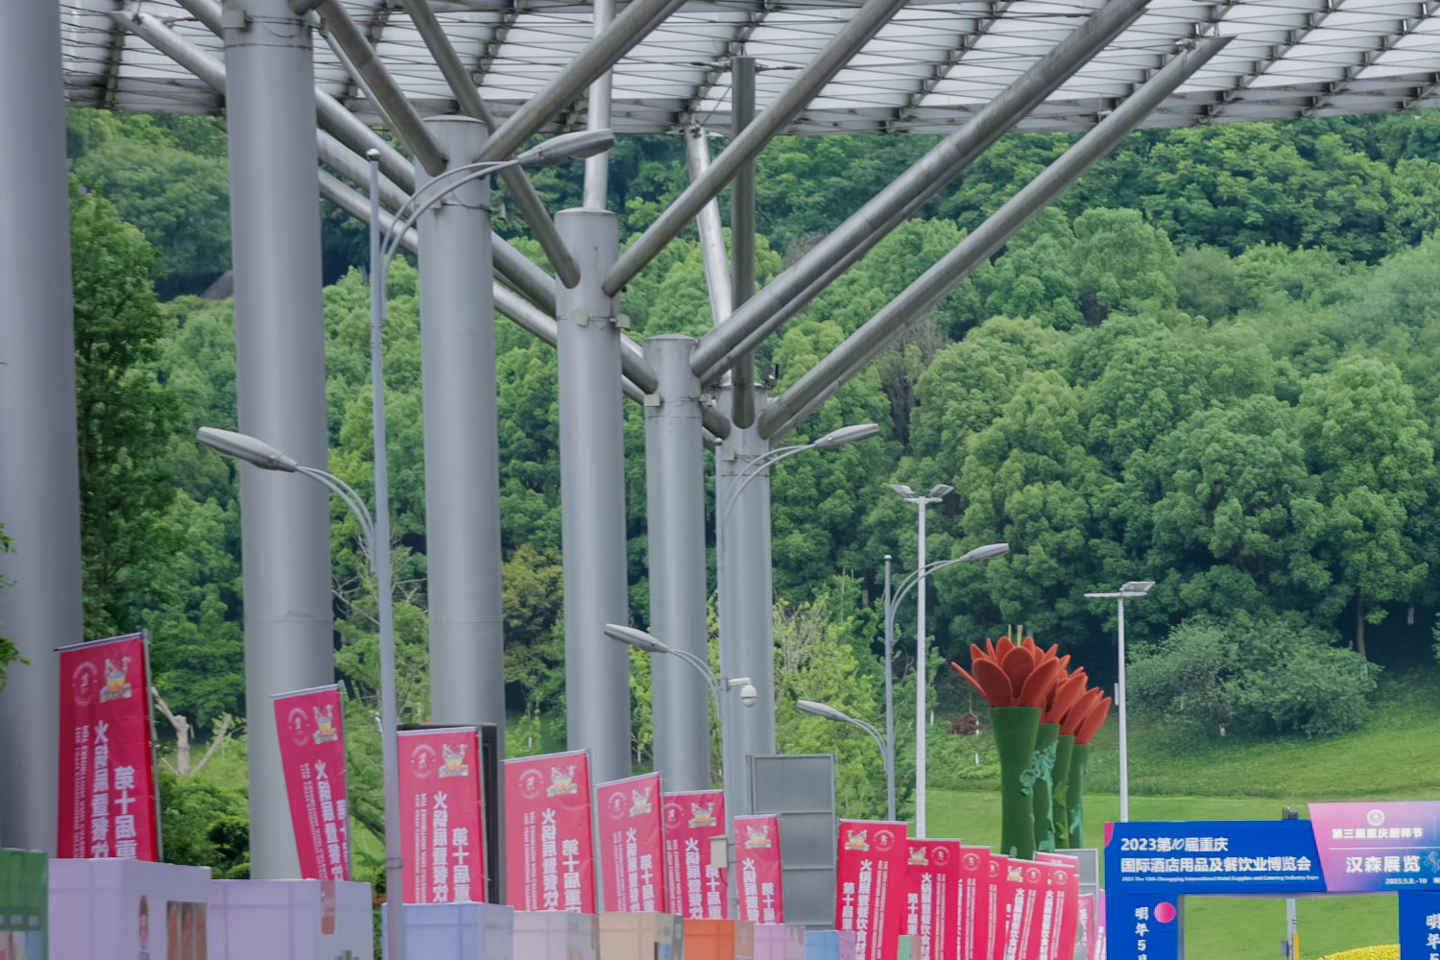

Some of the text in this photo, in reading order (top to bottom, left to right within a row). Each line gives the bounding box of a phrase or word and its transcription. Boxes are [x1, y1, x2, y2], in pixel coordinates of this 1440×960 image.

[1121, 837, 1229, 852] 2023第10届重庆
[1121, 857, 1311, 873] 国际酒店用品及餐饮业博览会
[1346, 855, 1421, 873] 汉森展览
